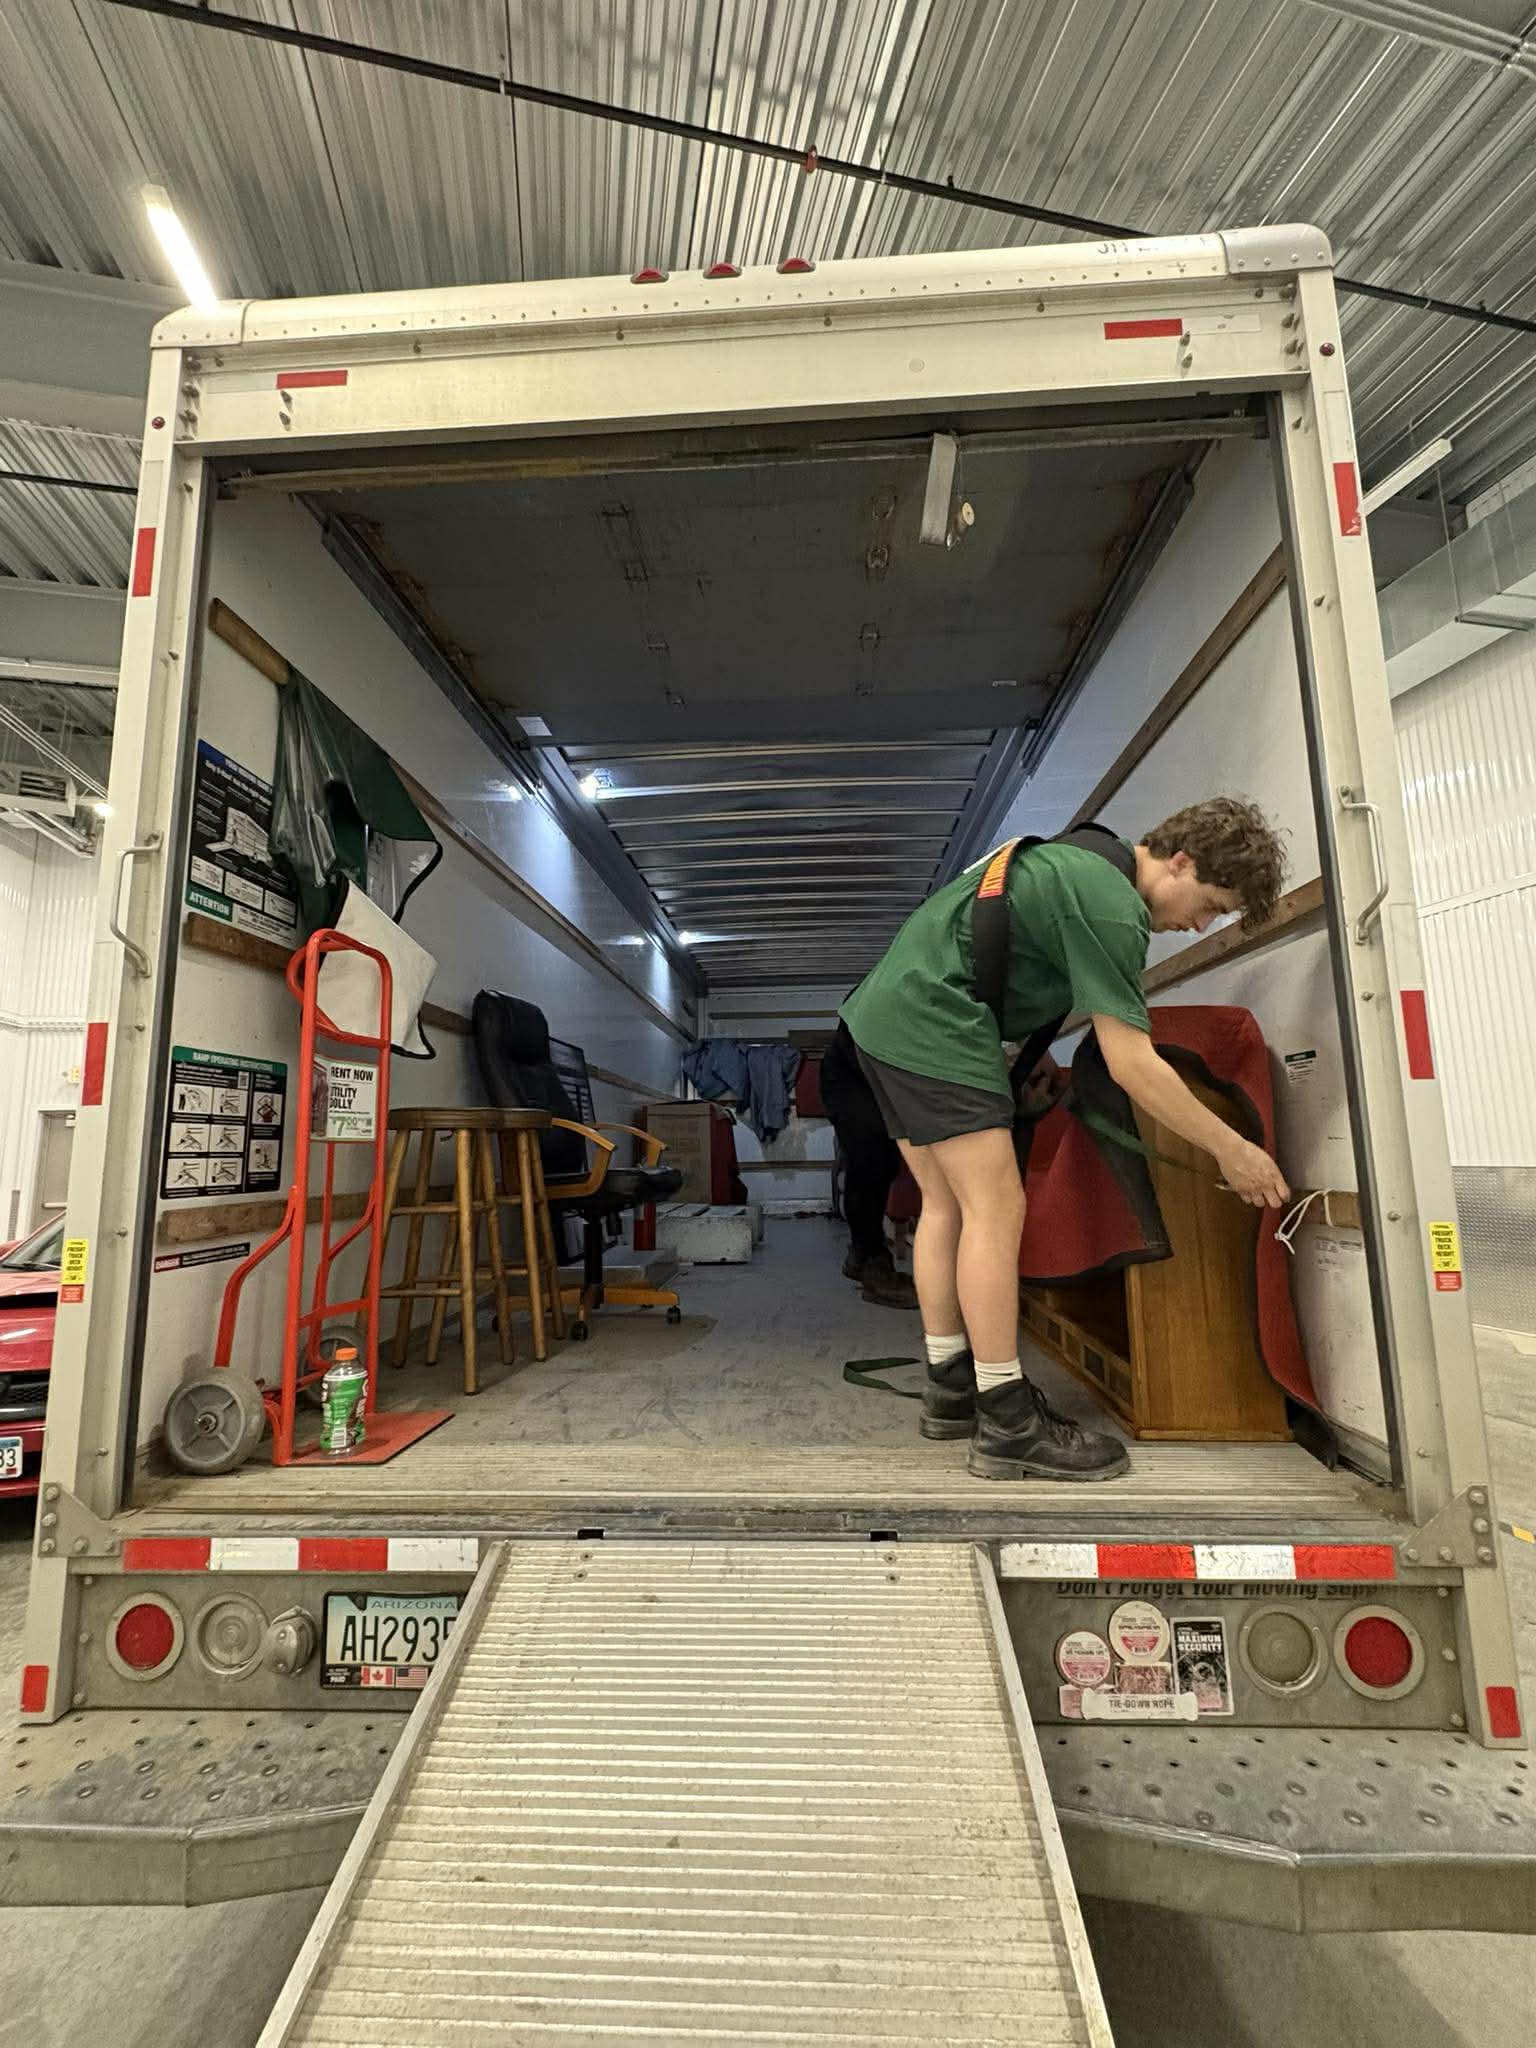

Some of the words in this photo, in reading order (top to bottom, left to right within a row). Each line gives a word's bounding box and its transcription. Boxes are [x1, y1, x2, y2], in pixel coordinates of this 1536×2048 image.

[189, 891, 230, 916] ATTENTION
[331, 1066, 352, 1079] RENT
[353, 1070, 374, 1081] NOW
[1056, 1582, 1111, 1595] Dont
[371, 1600, 456, 1610] ARIZONA
[1177, 1634, 1221, 1643] MAXIMUM
[1177, 1642, 1222, 1653] SECURITY
[1108, 1699, 1151, 1709] TIE-DOWN
[1152, 1699, 1175, 1709] ROPE
